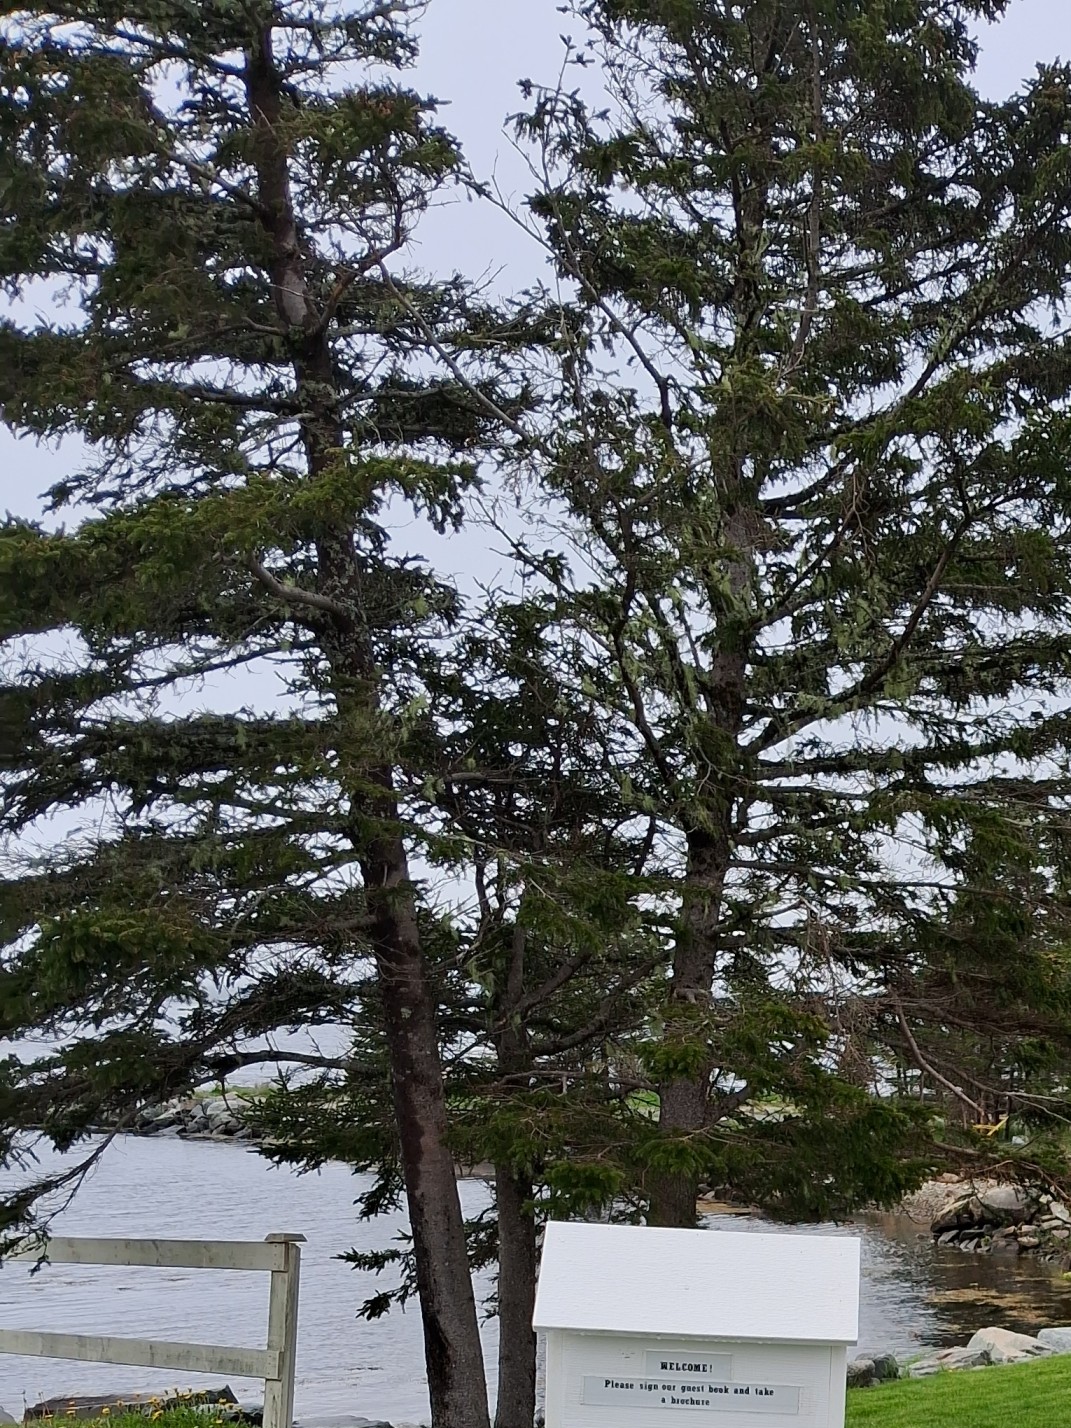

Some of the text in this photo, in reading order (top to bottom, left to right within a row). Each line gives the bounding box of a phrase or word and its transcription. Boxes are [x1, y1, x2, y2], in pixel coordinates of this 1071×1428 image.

[660, 1361, 713, 1373] WELCOME!
[604, 1379, 774, 1397] Please sign our guest book and take
[671, 1396, 710, 1406] brochure
